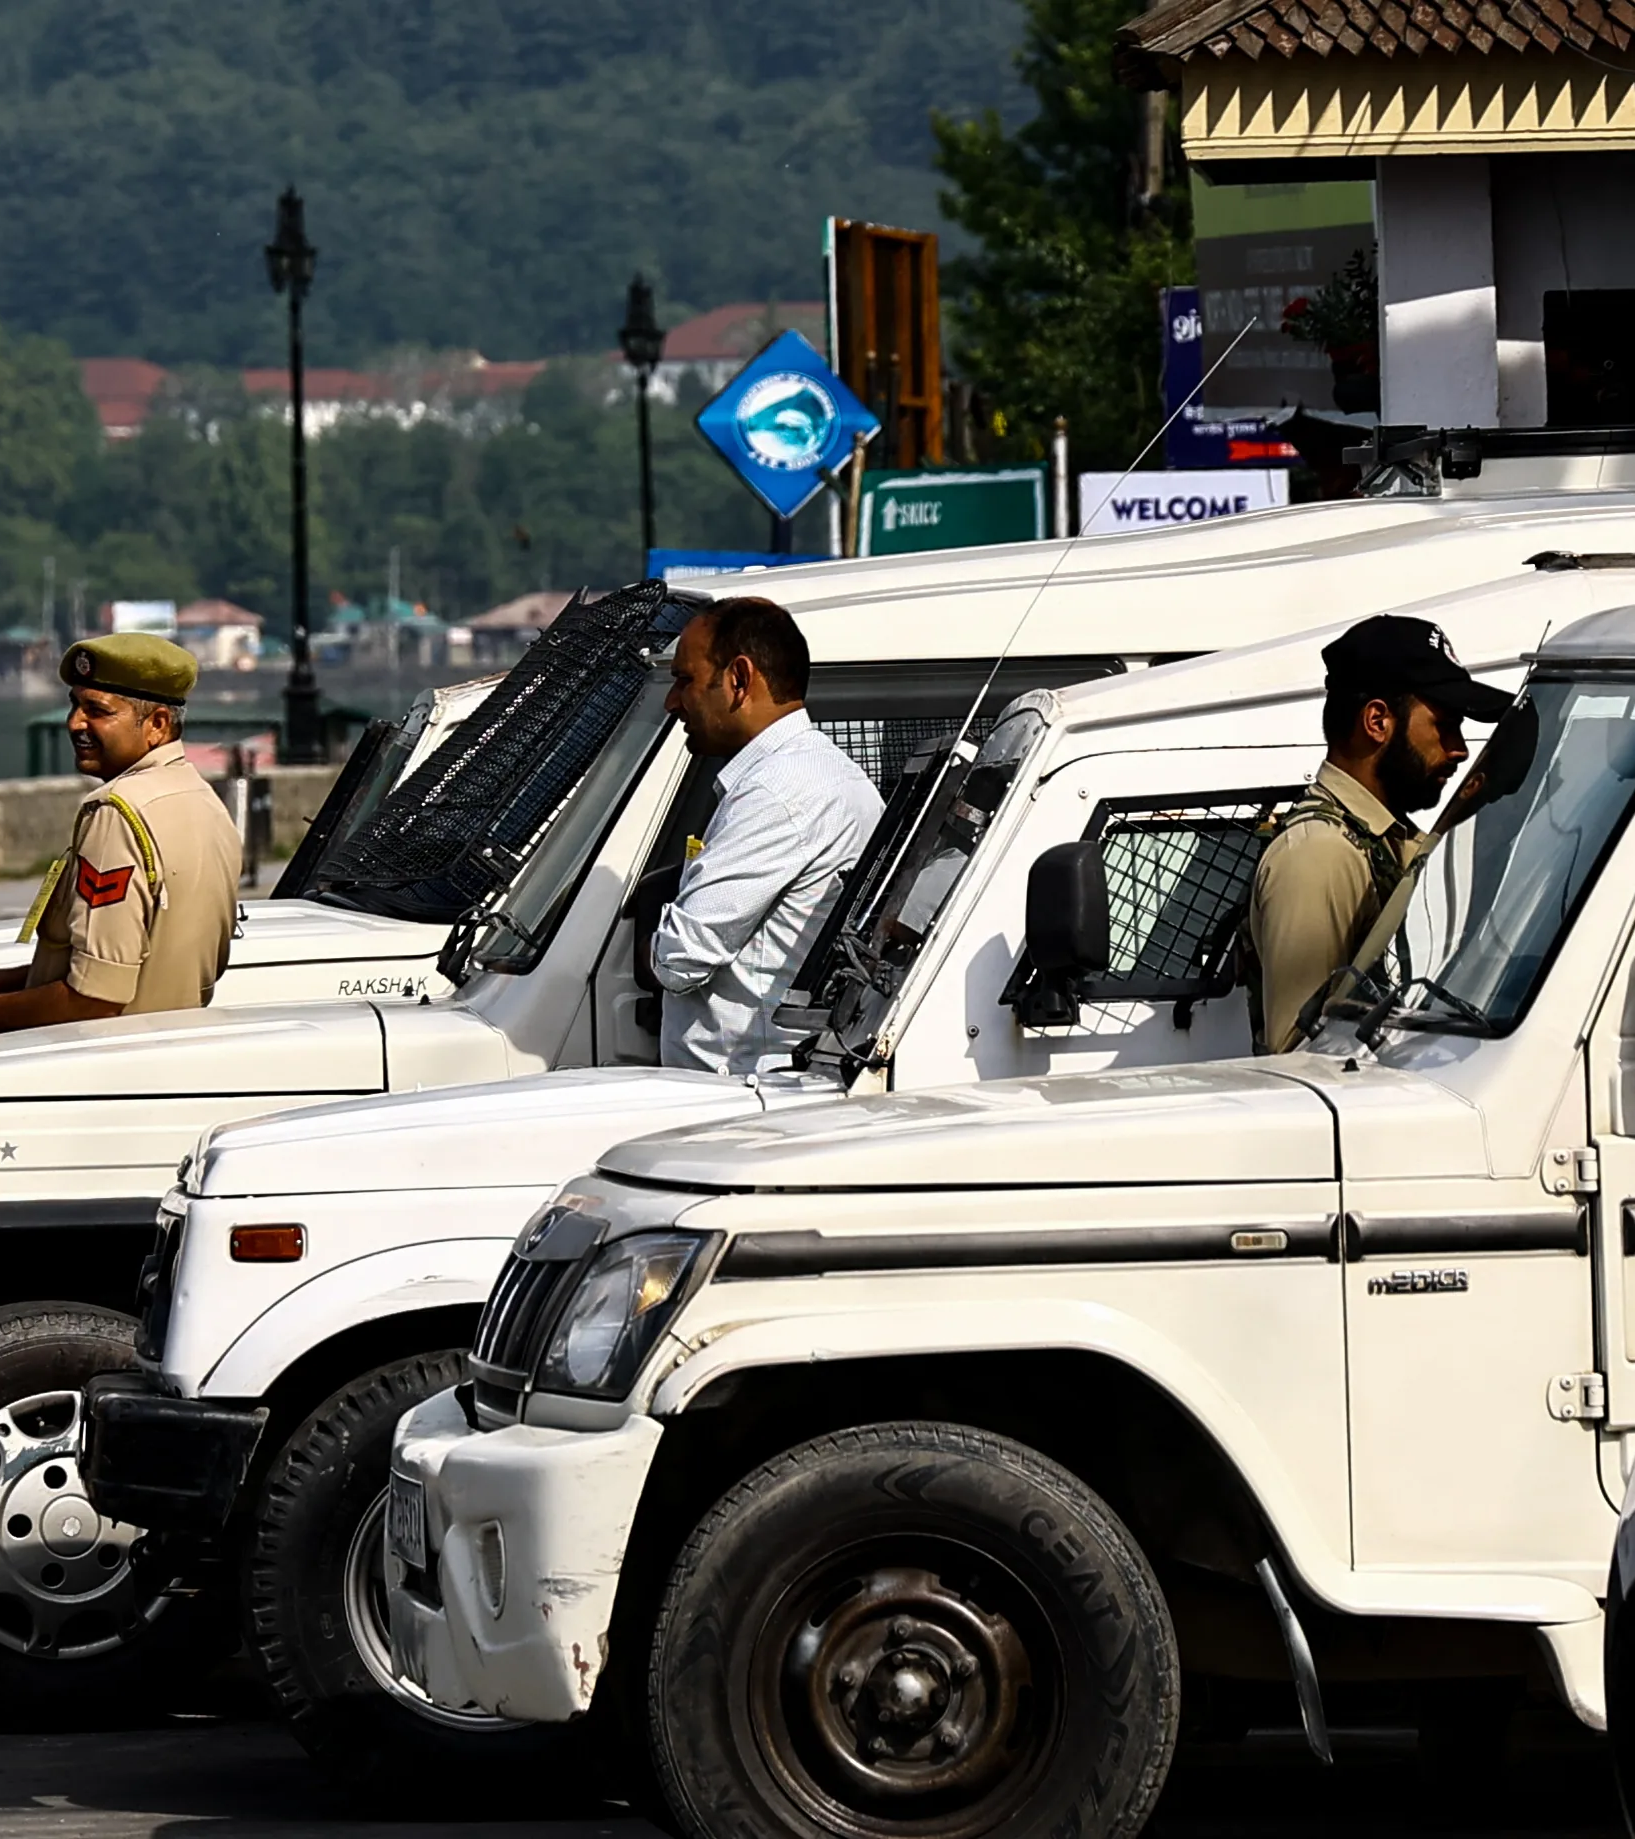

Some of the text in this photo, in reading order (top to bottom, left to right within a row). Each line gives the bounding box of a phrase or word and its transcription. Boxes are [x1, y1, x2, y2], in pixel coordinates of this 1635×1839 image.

[1111, 496, 1249, 521] WELCOME
[338, 976, 429, 996] RAKSHAK
[1019, 1509, 1124, 1622] CEAT
